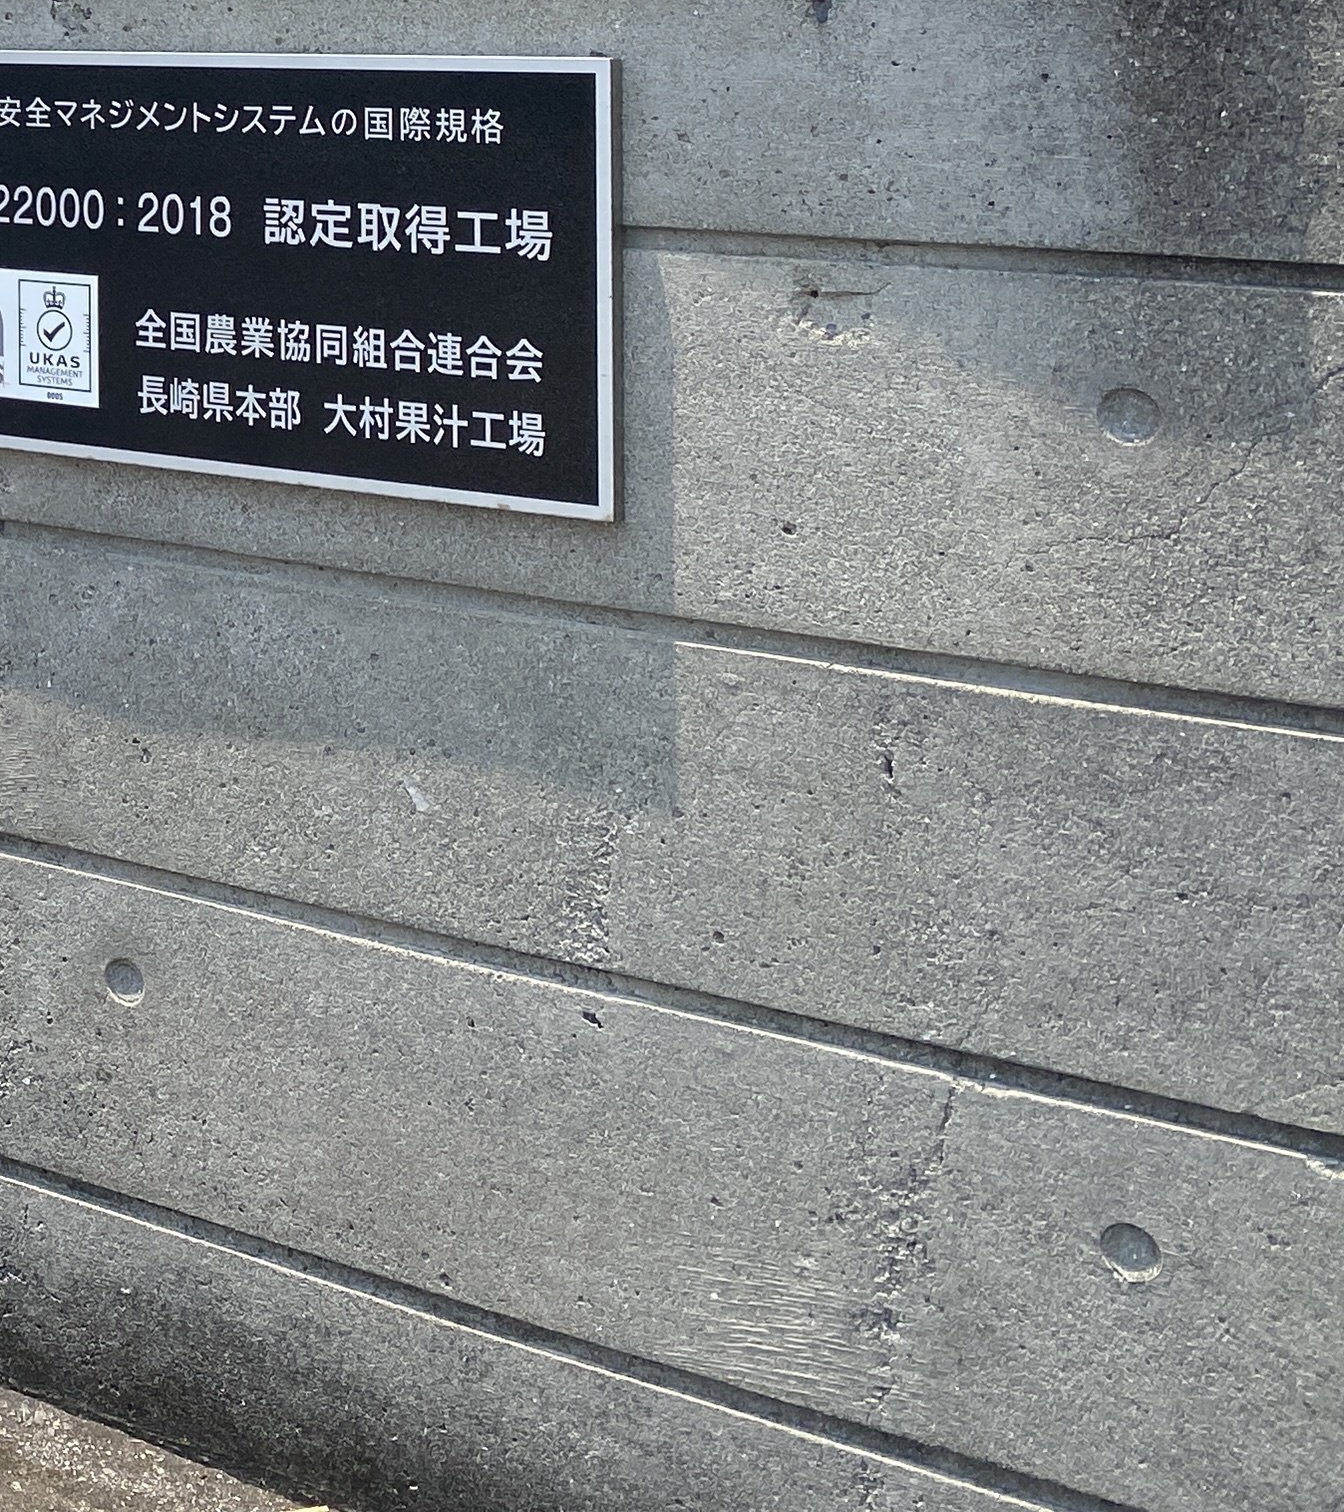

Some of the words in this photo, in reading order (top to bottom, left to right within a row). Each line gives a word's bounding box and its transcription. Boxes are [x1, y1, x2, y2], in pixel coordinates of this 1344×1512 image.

[263, 197, 553, 262] 認定取得工場
[29, 351, 81, 369] UKAS
[135, 308, 544, 383] 全国農業協同組合連合会
[26, 365, 83, 378] MANAGEMENT
[37, 375, 73, 386] SYSTEMS
[137, 374, 301, 431] 長崎県本部
[323, 393, 546, 457] 大村果汁工場
